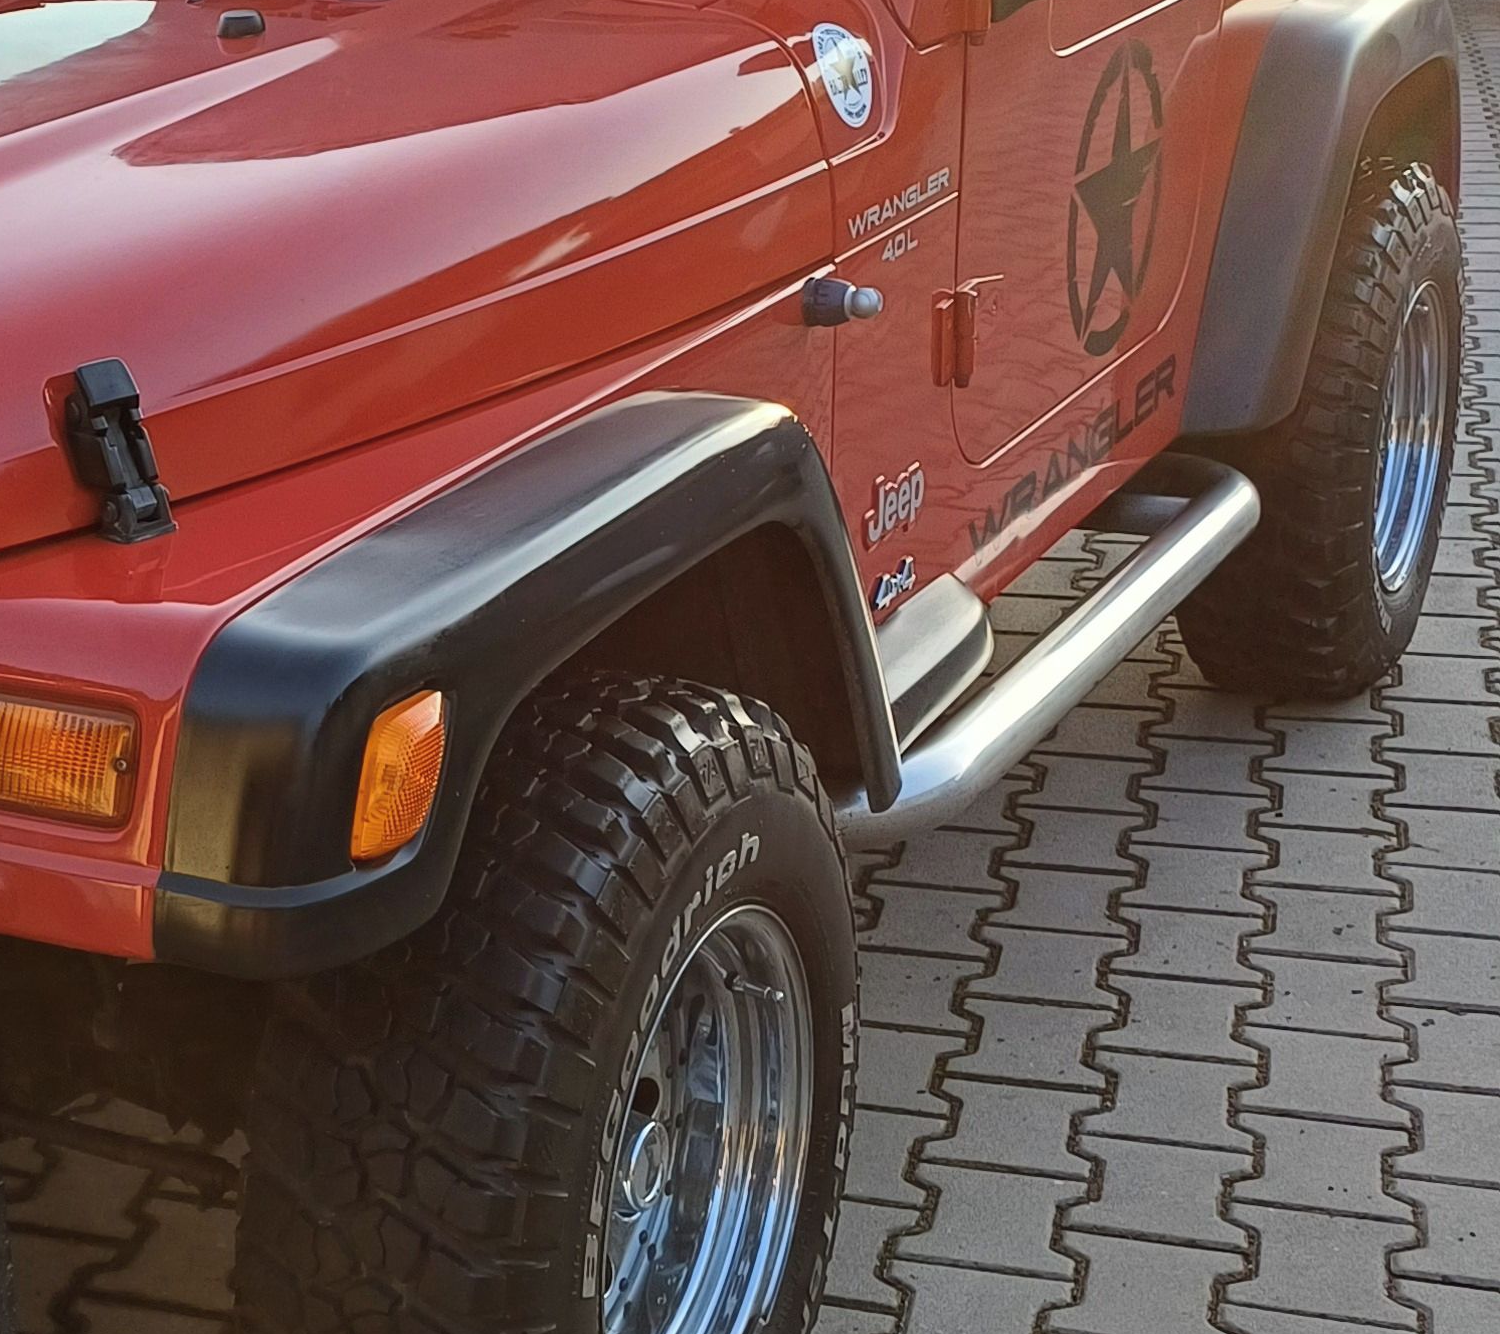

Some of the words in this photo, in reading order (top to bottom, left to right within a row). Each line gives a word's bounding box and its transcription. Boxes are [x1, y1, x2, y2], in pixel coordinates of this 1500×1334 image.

[847, 166, 951, 240] WRANGLER
[866, 465, 925, 544] Jeep
[967, 353, 1177, 563] WRANGLER
[582, 831, 761, 1299] BFGoodrich
